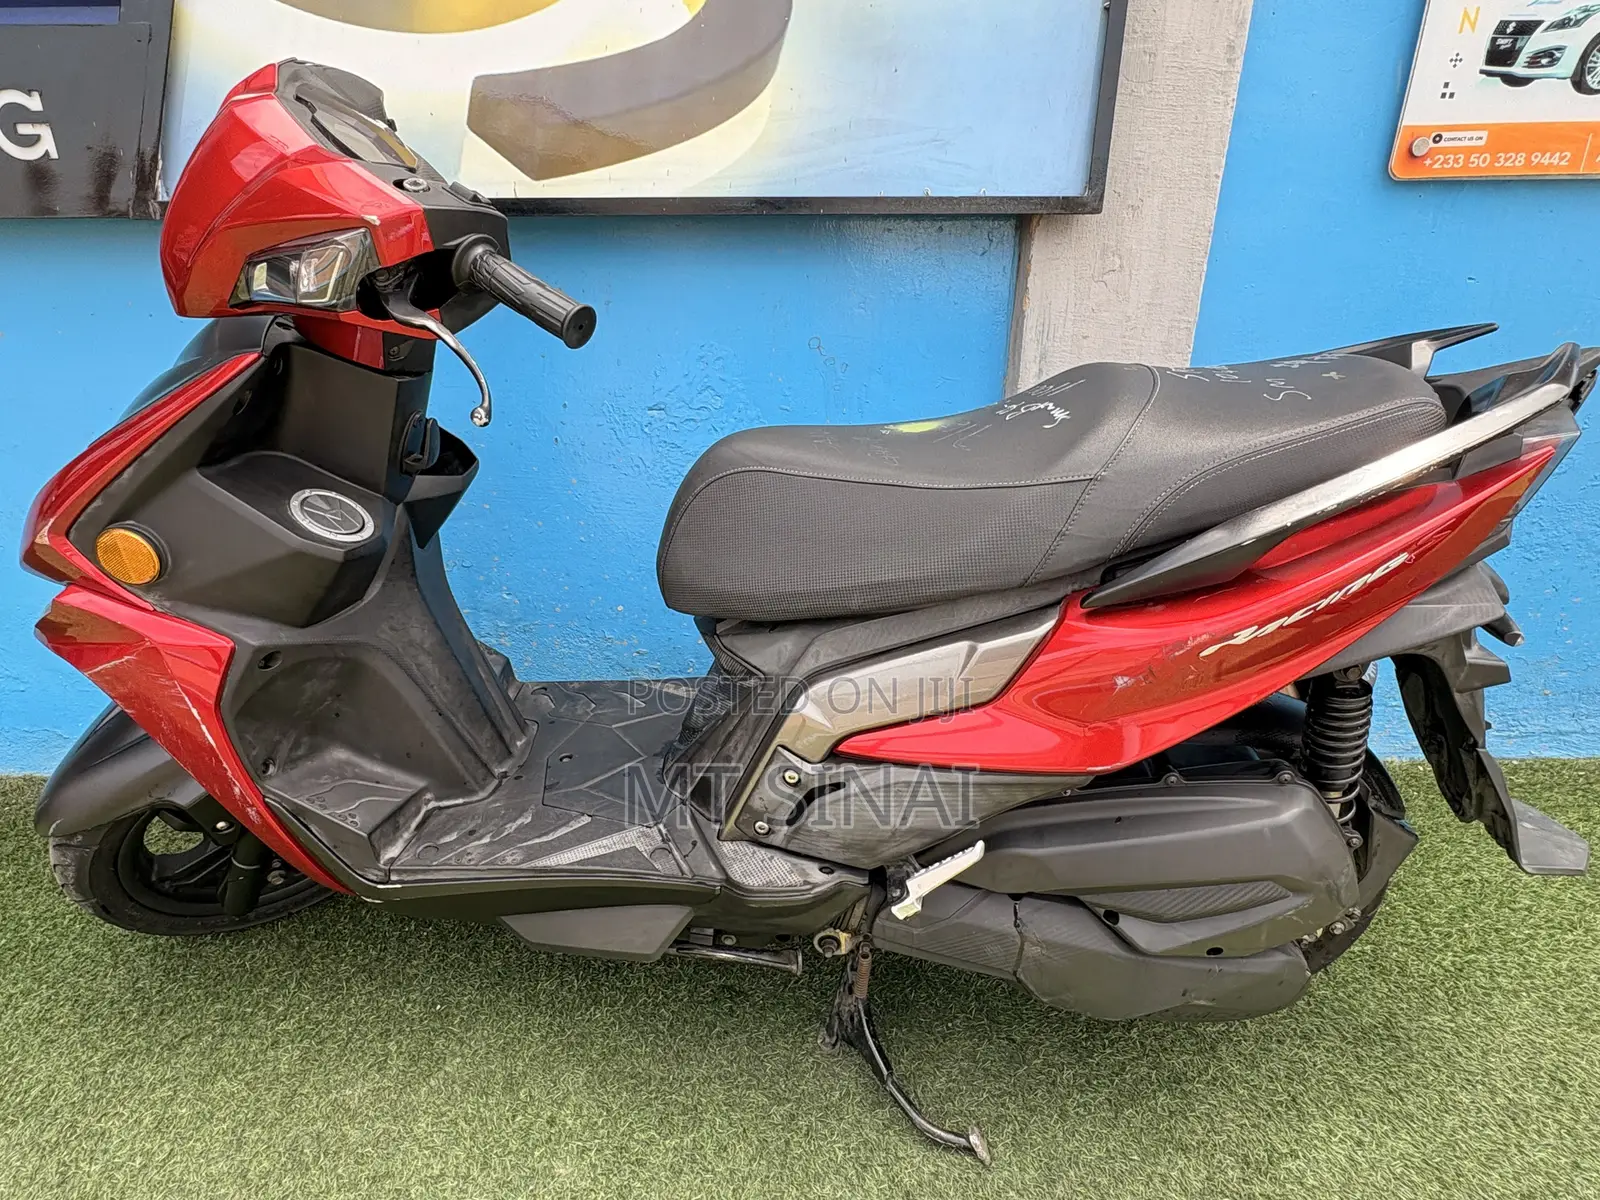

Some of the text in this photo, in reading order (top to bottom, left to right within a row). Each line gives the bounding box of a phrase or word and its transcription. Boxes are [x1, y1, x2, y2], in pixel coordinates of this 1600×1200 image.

[1458, 6, 1480, 34] N
[0, 89, 59, 161] G
[1423, 151, 1571, 169] +233 50 328 9442
